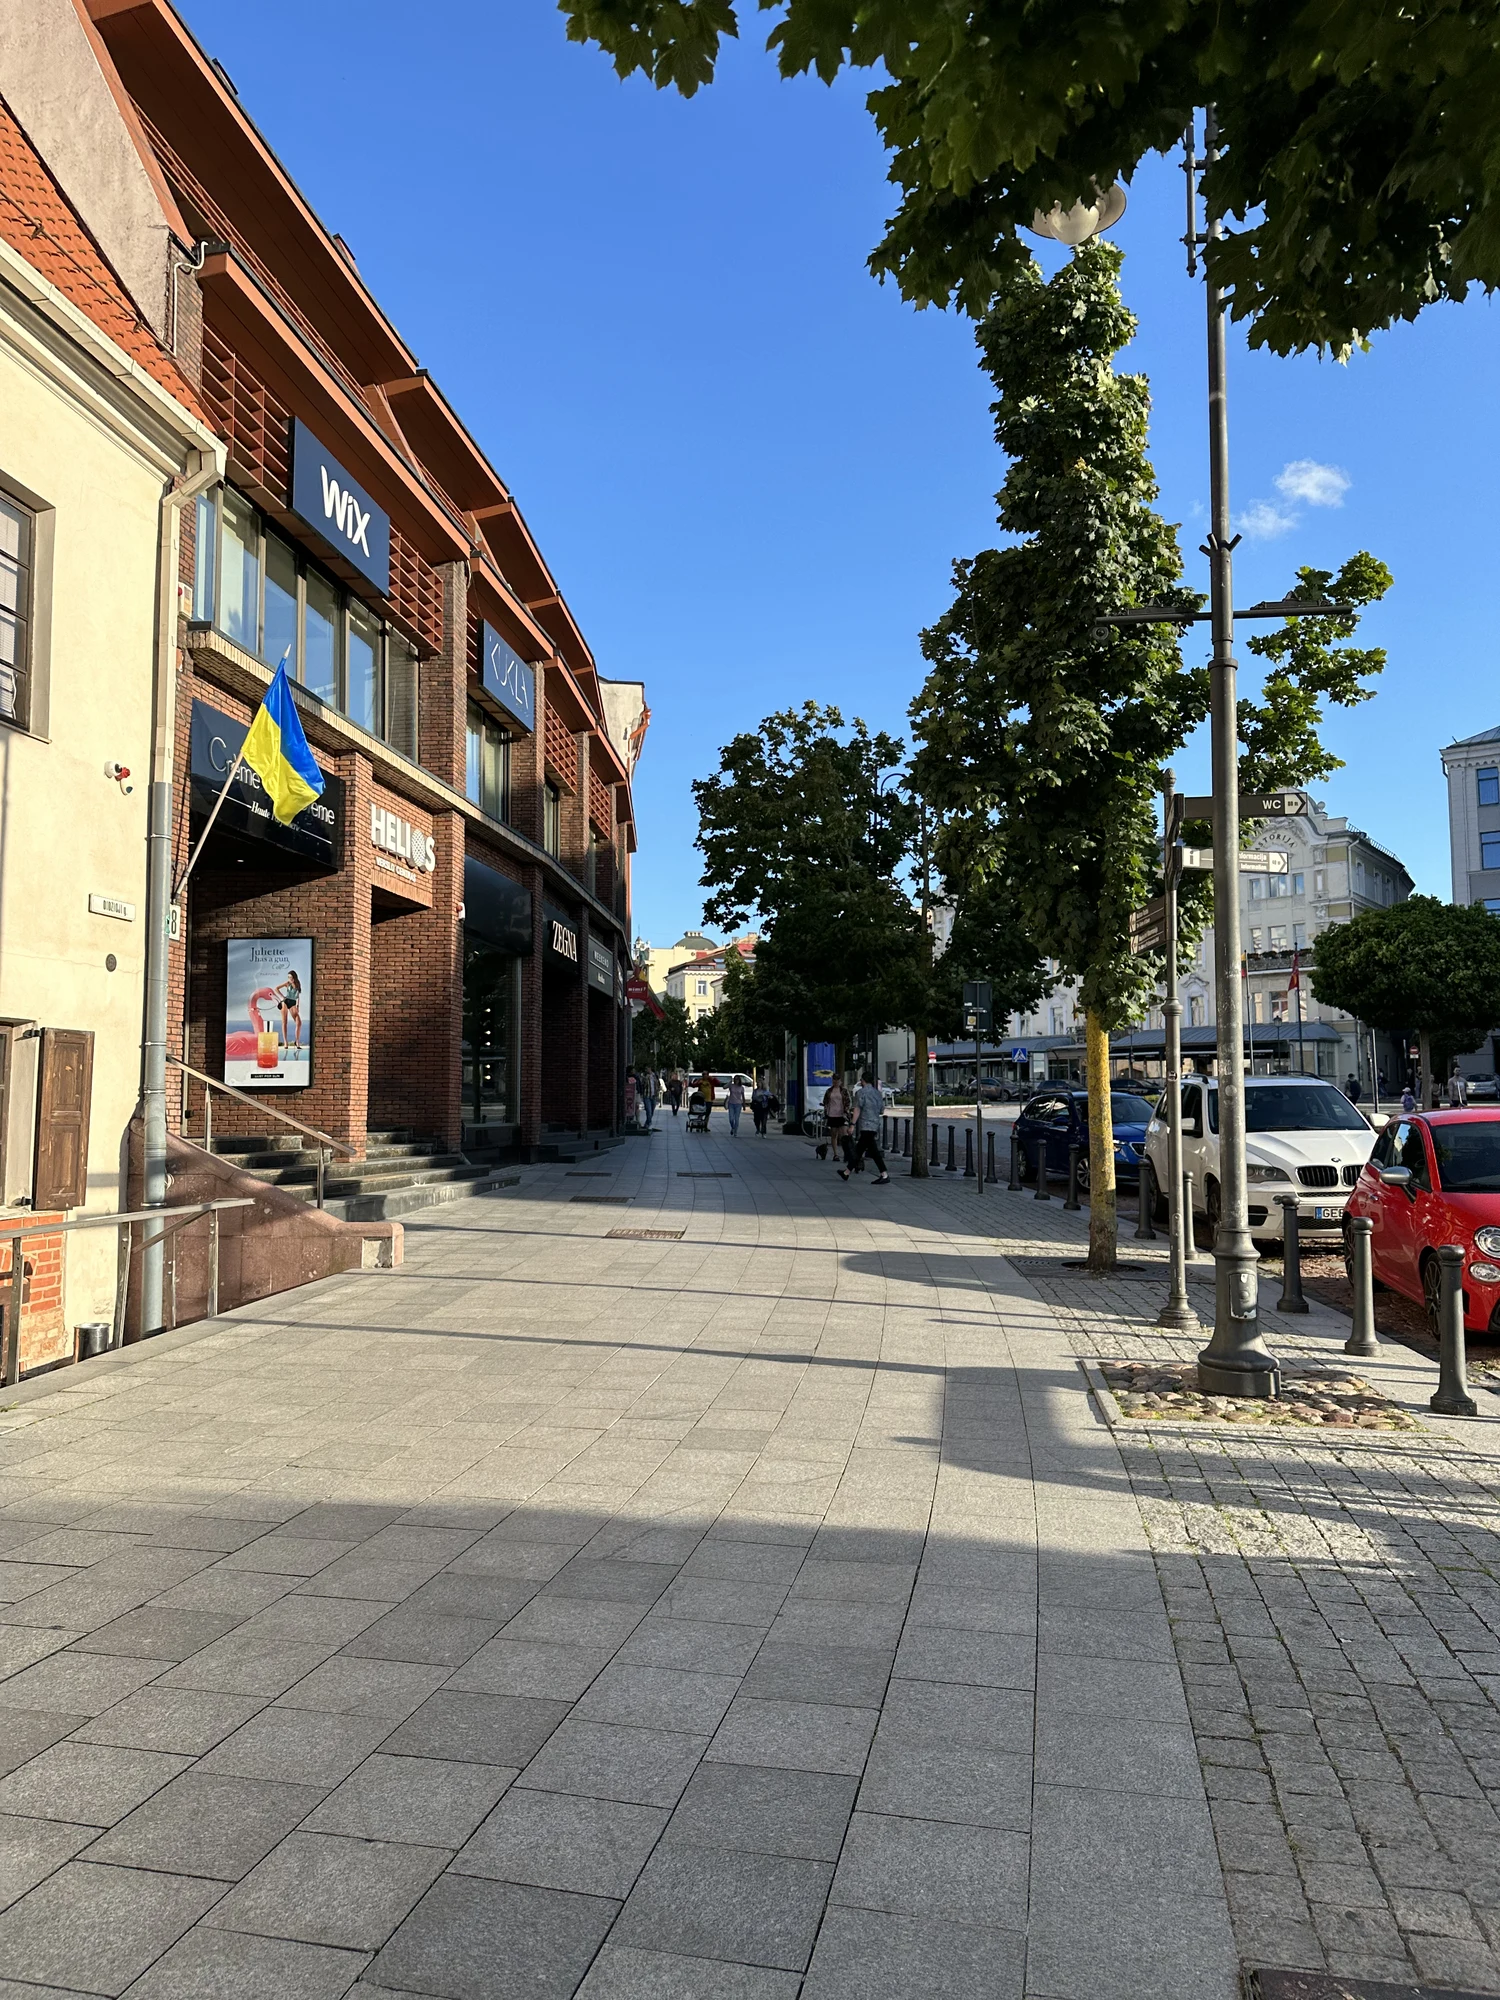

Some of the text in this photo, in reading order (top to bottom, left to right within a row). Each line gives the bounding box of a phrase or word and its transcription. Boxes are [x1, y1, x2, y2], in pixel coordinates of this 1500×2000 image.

[1262, 800, 1281, 810] WC
[371, 803, 436, 872] HELIOS
[171, 909, 177, 935] 8
[552, 920, 578, 962] ZEGNA
[249, 947, 285, 962] Juliette
